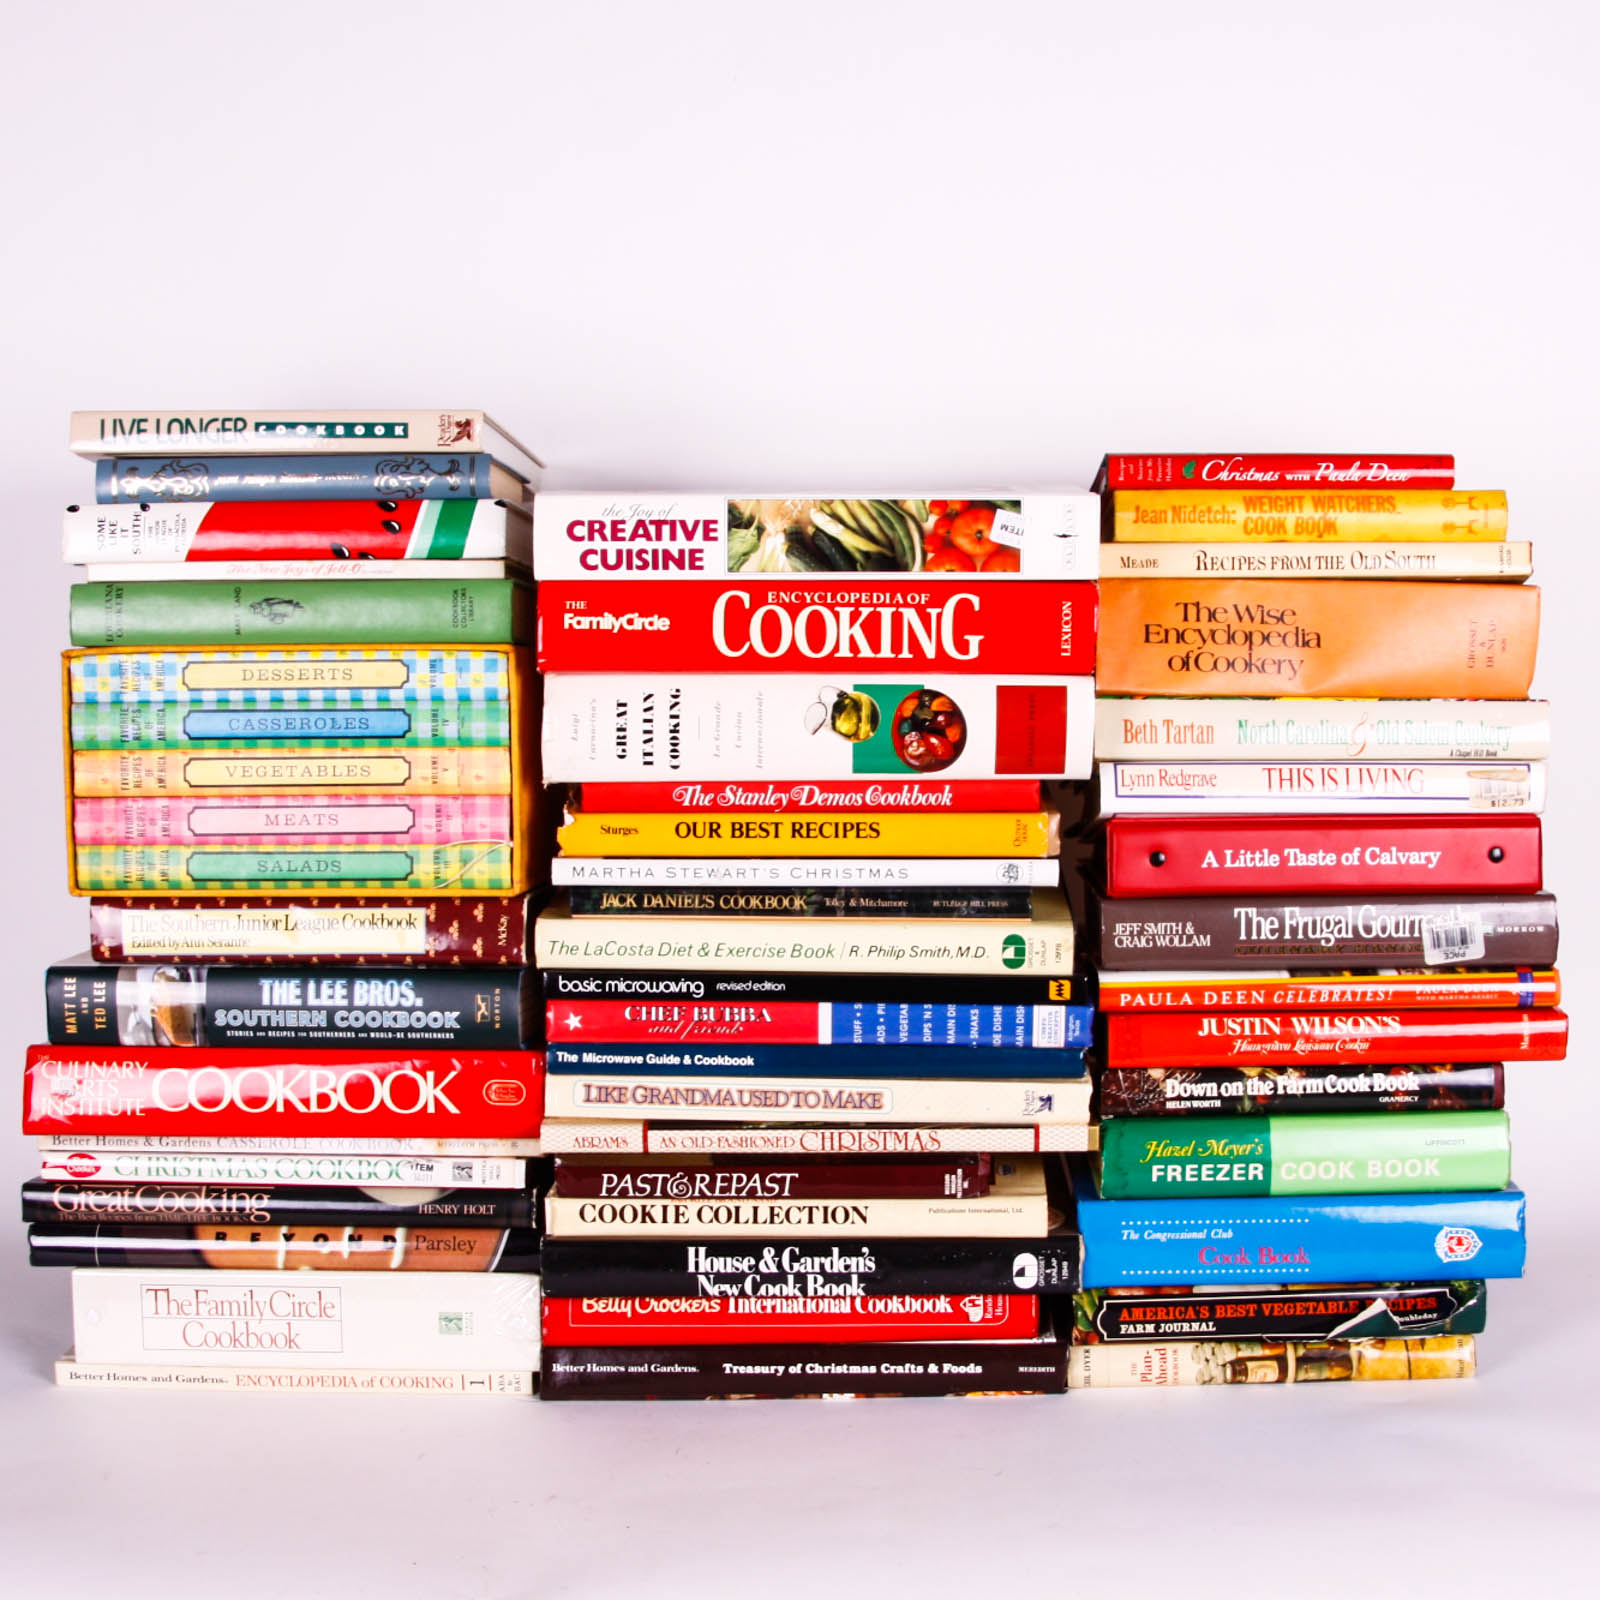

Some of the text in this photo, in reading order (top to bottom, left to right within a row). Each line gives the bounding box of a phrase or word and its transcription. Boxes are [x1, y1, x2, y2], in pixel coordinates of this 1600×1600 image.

[100, 417, 404, 444] LIVE LONGER COOKBOOK
[1132, 505, 1237, 525] Jean Nidetch:
[566, 519, 719, 542] CREATIVE
[1243, 515, 1338, 538] COOK BOOK
[579, 548, 705, 571] CUISINE
[1119, 555, 1160, 569] MEADE
[564, 600, 588, 610] THE
[767, 591, 931, 605] ENCYCLOPEDIA OF
[1174, 600, 1297, 626] The Wise
[712, 590, 985, 660] COOKING
[1060, 601, 1072, 656] LEXICON
[1143, 623, 1322, 652] Encyclopedia
[242, 668, 353, 681] DESSERTS
[1167, 650, 1305, 681] of Cookery
[229, 717, 370, 731] CASSEROLES
[615, 699, 628, 760] GREAT
[642, 692, 654, 766] ITALIAN
[669, 688, 681, 770] COOKING
[1122, 718, 1215, 745] Beth Tartan
[226, 765, 371, 778] VEGETABLES
[1120, 767, 1218, 791] Lynn Redgrave
[1262, 767, 1424, 794] THIS IS LIVING
[672, 783, 953, 813] The Stanley Demos Cookbook
[264, 813, 339, 826] MEATS
[600, 823, 639, 836] Sturges
[674, 820, 881, 839] OUR BEST RECIPES
[257, 860, 342, 873] SALADS
[1201, 846, 1443, 869] A Little Taste of Calvary
[571, 865, 911, 880] MARTHA STEWART'S CHRISTMAS
[600, 892, 809, 911] JACK DANIEL'S COOKBOOK
[1112, 921, 1195, 936] JEFF SMITH &
[1233, 905, 1354, 947] The Frugal
[548, 940, 836, 959] The LaCosta Diet & Exercise Book
[1114, 934, 1212, 948] CRAIG WOLLAM
[258, 978, 423, 1007] THE LEE BROS.
[558, 976, 705, 998] basic microwaving
[715, 980, 786, 992] revised edition
[64, 976, 78, 1034] MATT LEE
[93, 981, 107, 1030] TED LEE
[1119, 988, 1394, 1007] PAULA DEEN CELEBRATES!
[214, 1008, 461, 1028] SOUTHERN COOKBOOK
[623, 1005, 772, 1023] CHEF BUBBA
[969, 1008, 980, 1041] SNAKS
[853, 1015, 863, 1044] STUFF
[1197, 1015, 1402, 1037] JUSTIN WILSON'S
[556, 1050, 755, 1066] The Microwave Guide & Cookbook
[40, 1060, 149, 1079] CULINARY
[152, 1067, 461, 1114] COOKBOOK
[1165, 1071, 1421, 1099] Down on the Farm Cook Book
[583, 1083, 884, 1110] LIKE GRANDMA USED TO MAKE
[1165, 1099, 1222, 1109] HELEN WORTH
[1378, 1095, 1420, 1103] GRAMERCY
[573, 1135, 629, 1149] ABRAMS
[659, 1130, 942, 1152] AN OLD-FASHIONED CHRISTMAS
[1151, 1158, 1441, 1183] FREEZER COOK BOOK
[53, 1184, 271, 1224] Great Cooking
[418, 1203, 497, 1215] HENRY HOLT
[578, 1203, 869, 1225] COOKIE COLLECTION
[415, 1234, 477, 1256] Parsley
[1198, 1245, 1312, 1266] Cook Book
[686, 1246, 876, 1274] House & Garden's
[145, 1287, 336, 1324] The Family Circle
[182, 1319, 301, 1350] Cookbook
[1119, 1321, 1217, 1335] FARM JOURNAL
[552, 1362, 585, 1373] Better
[587, 1363, 625, 1373] Homes
[628, 1363, 648, 1373] and
[722, 1362, 983, 1377] Treasury of Christmas Crafts & Foods
